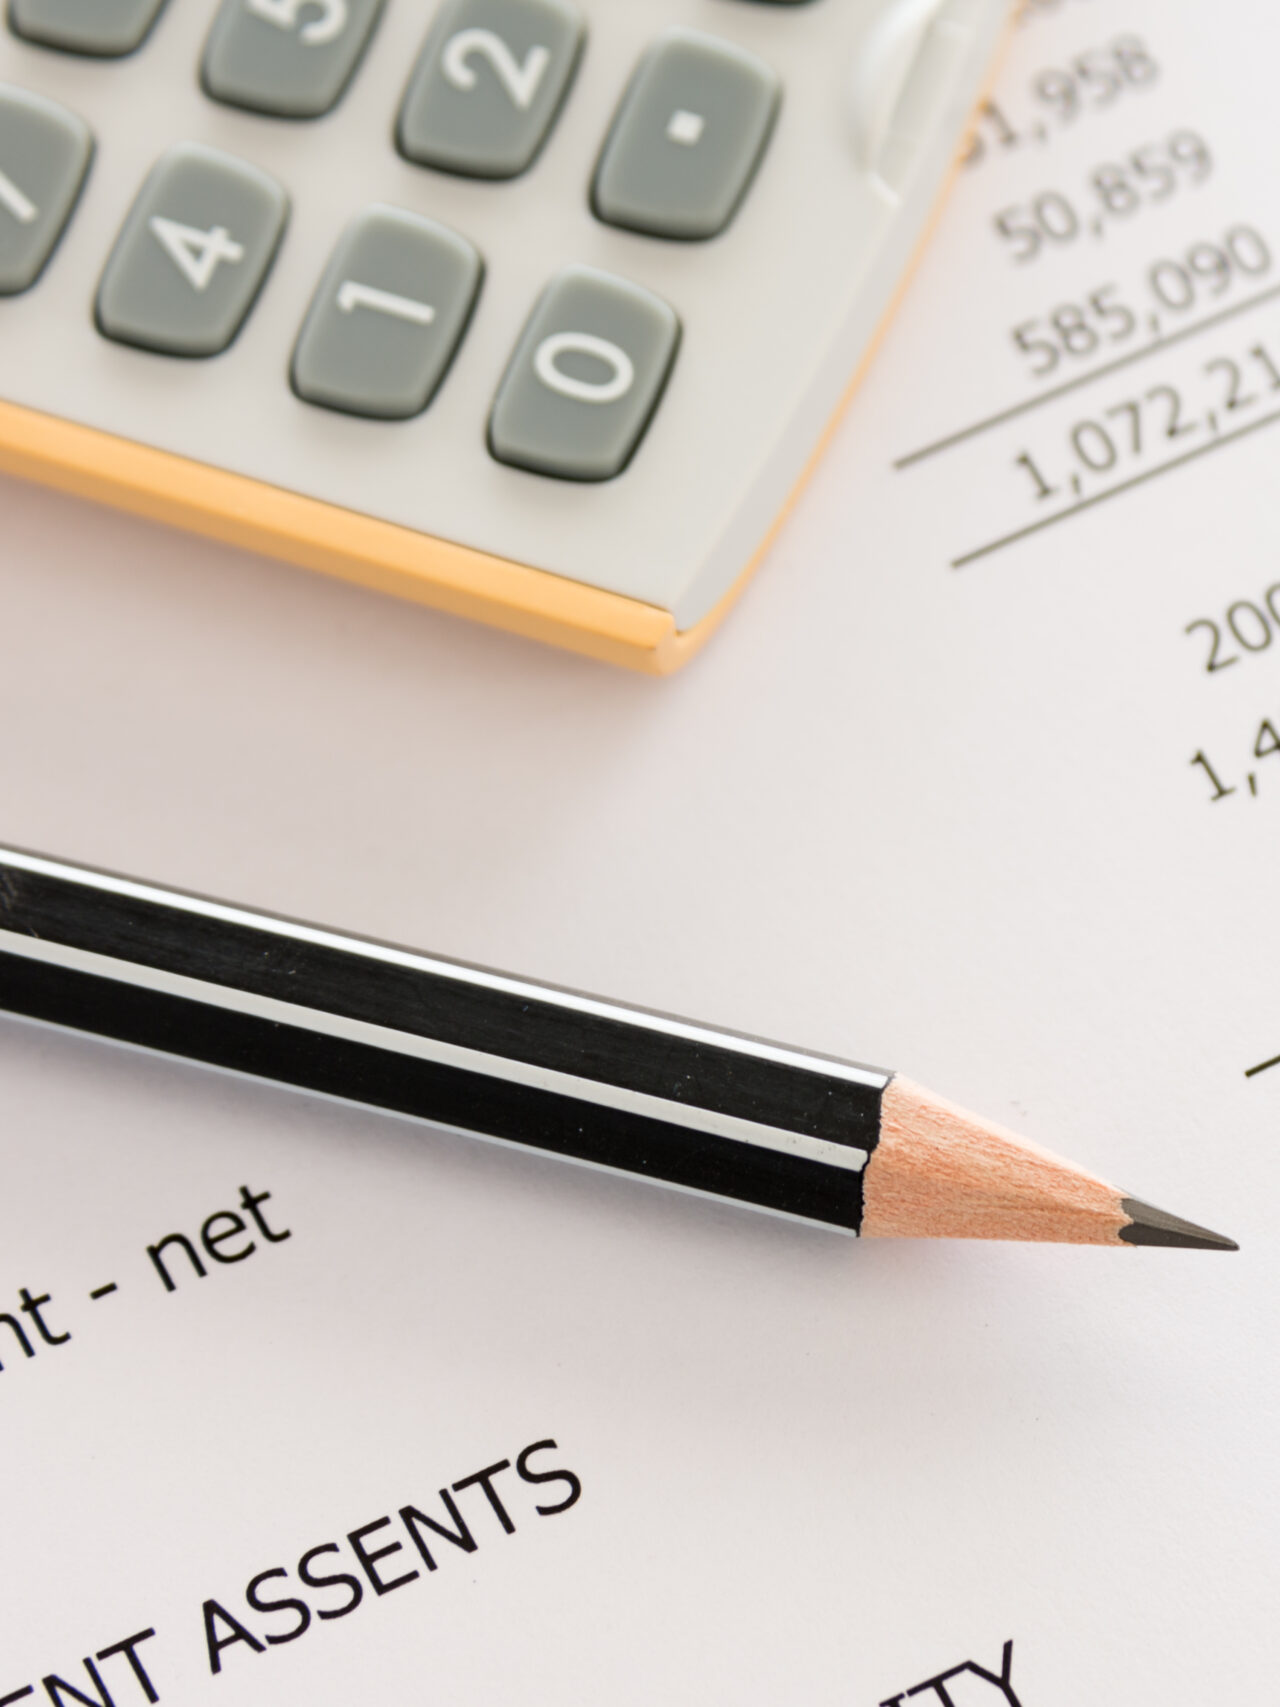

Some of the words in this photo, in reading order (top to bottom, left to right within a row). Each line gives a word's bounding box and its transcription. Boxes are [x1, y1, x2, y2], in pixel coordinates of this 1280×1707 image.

[442, 28, 549, 109] 2
[992, 130, 1214, 267] 50,859
[151, 216, 244, 290] 4
[337, 280, 436, 325] 1
[1012, 223, 1273, 380] 585,090
[534, 332, 634, 403] 0
[145, 1185, 292, 1293] net
[0, 1626, 161, 1707] NT
[202, 1438, 583, 1674] ASSENTS
[879, 1638, 1024, 1707] TY
